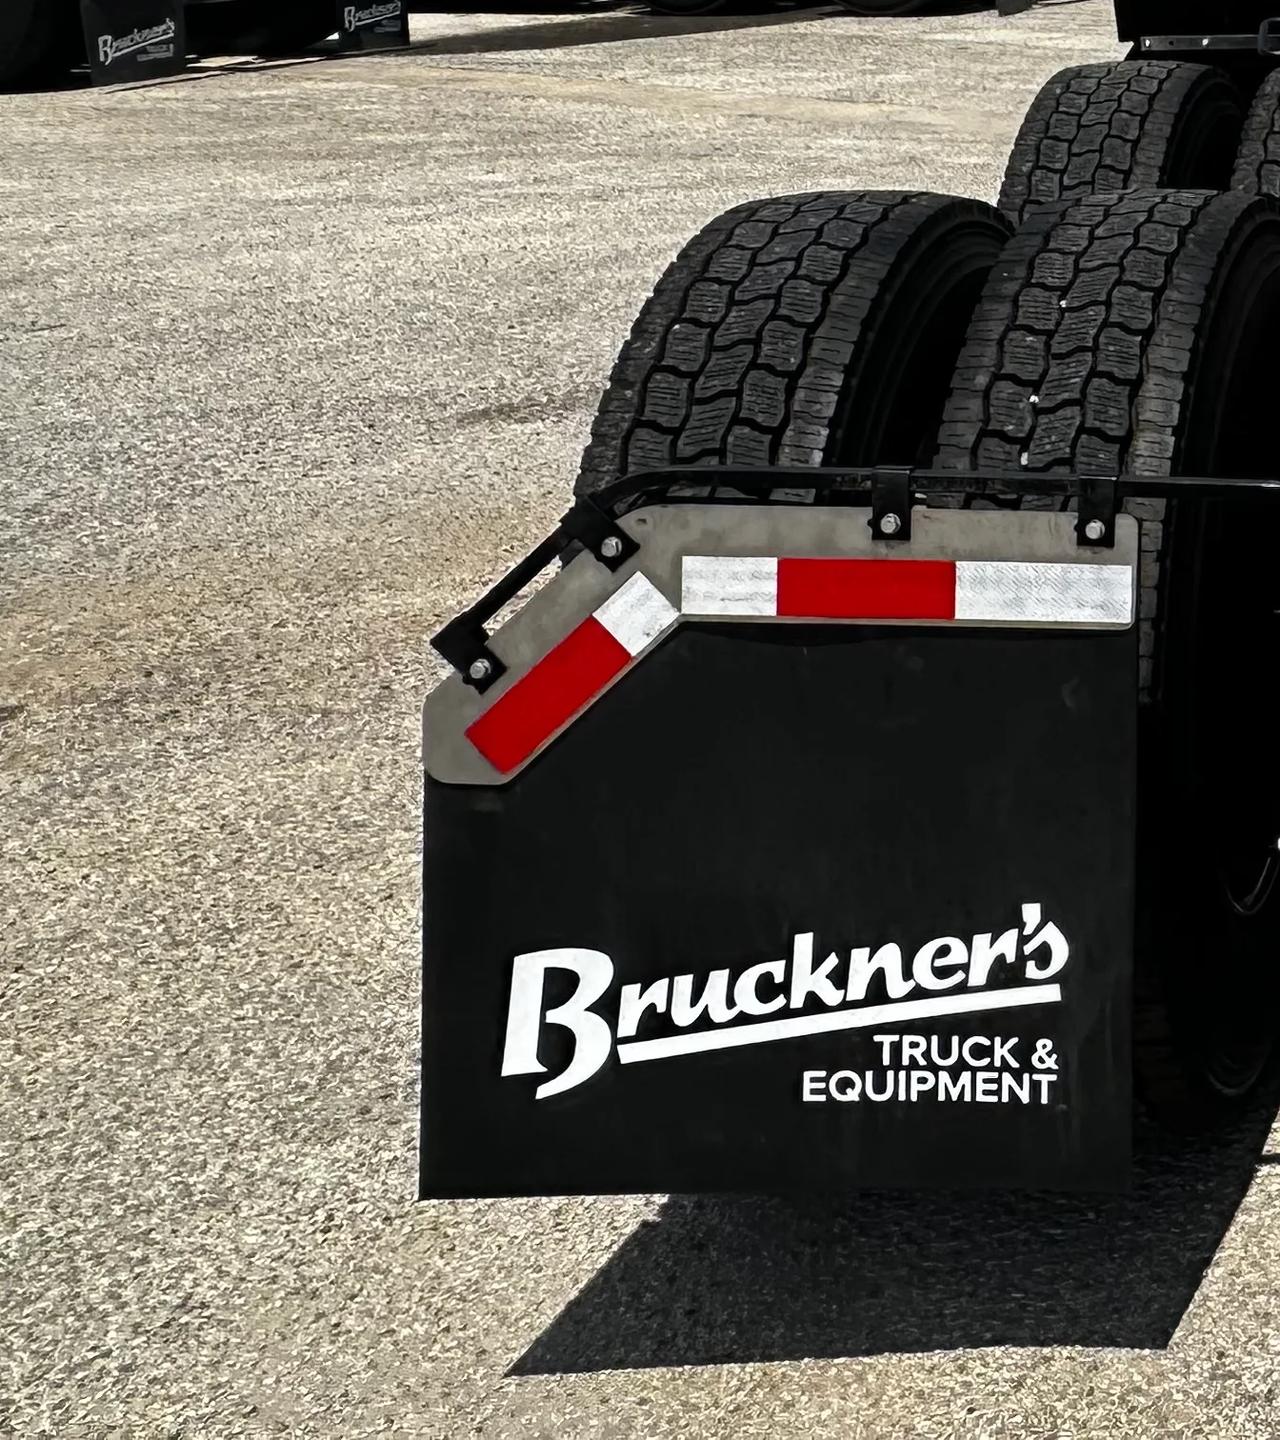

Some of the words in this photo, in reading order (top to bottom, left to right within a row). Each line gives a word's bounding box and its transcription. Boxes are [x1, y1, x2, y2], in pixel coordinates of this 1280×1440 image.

[500, 902, 1070, 1100] Bruckner's
[873, 1034, 1020, 1070] TRUCK
[1031, 1036, 1060, 1070] &
[802, 1070, 1058, 1105] EQUIPMENT
